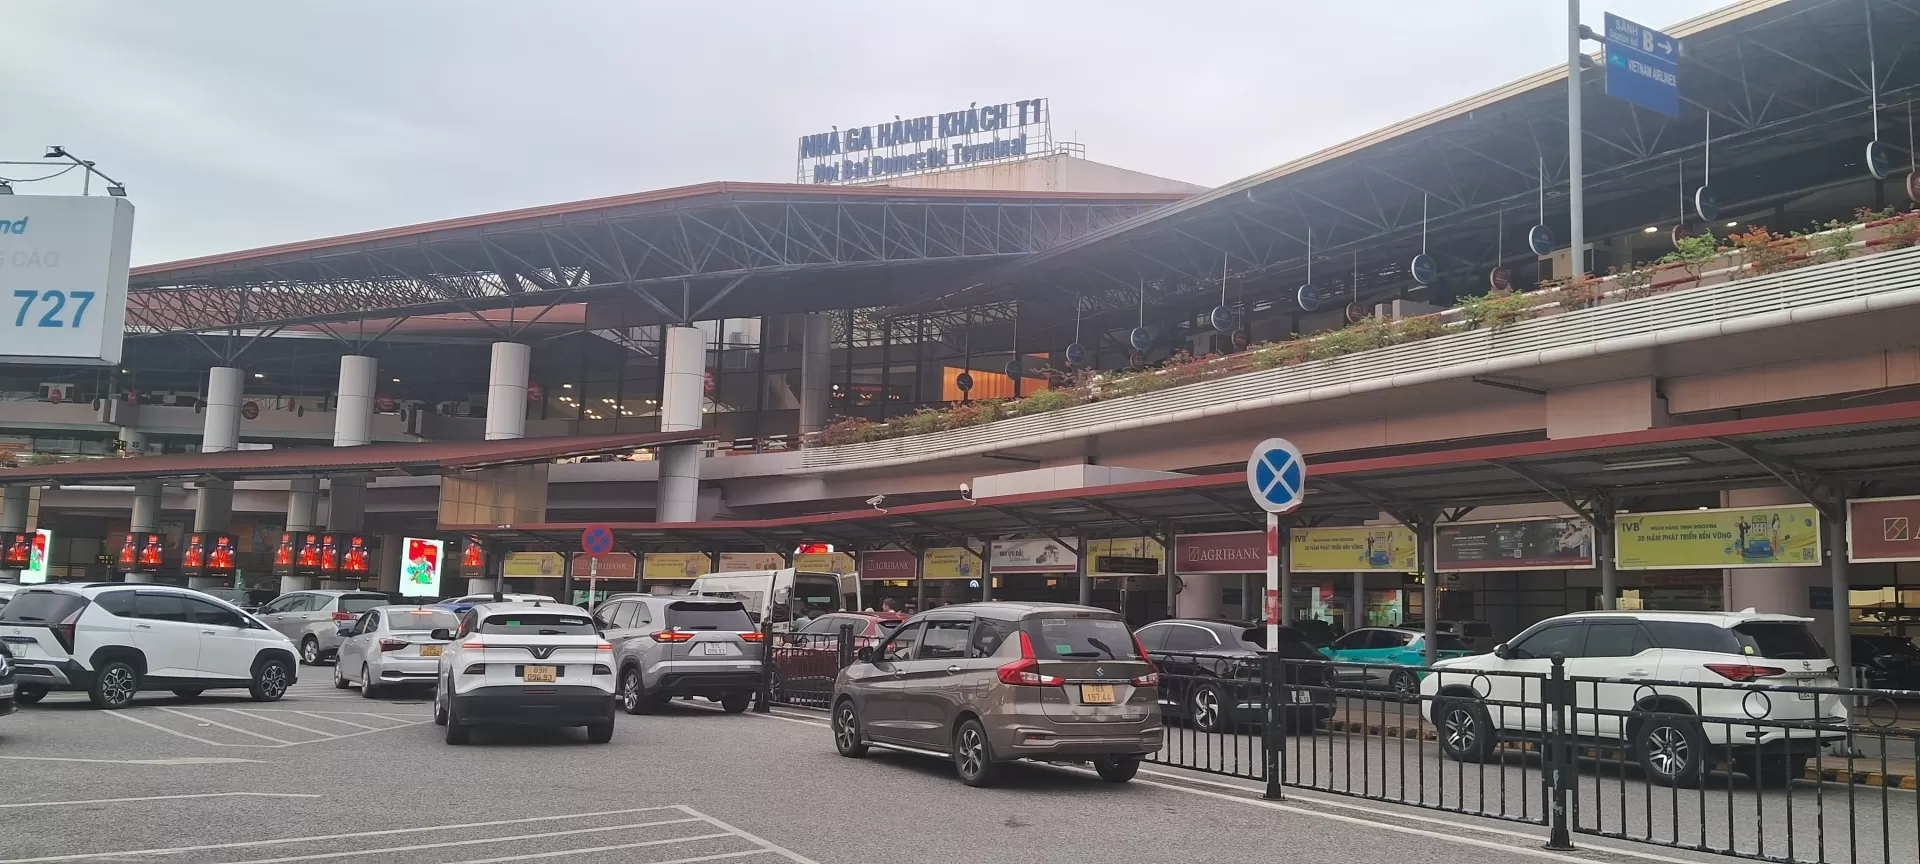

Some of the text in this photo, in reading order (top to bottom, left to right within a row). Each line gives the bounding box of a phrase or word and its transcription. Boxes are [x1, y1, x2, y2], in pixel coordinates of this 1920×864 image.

[1642, 29, 1654, 53] B
[1628, 58, 1676, 87] VIETNAM AIRLINES
[801, 98, 1041, 158] NHÀ GA HÀNH KHÁCH T1
[872, 147, 948, 176] Domestic
[952, 133, 1026, 164] Terminal
[14, 290, 95, 328] 727
[1622, 522, 1640, 532] IVB
[874, 561, 910, 570] AGRIBANK
[1200, 548, 1260, 561] AGRIBANK
